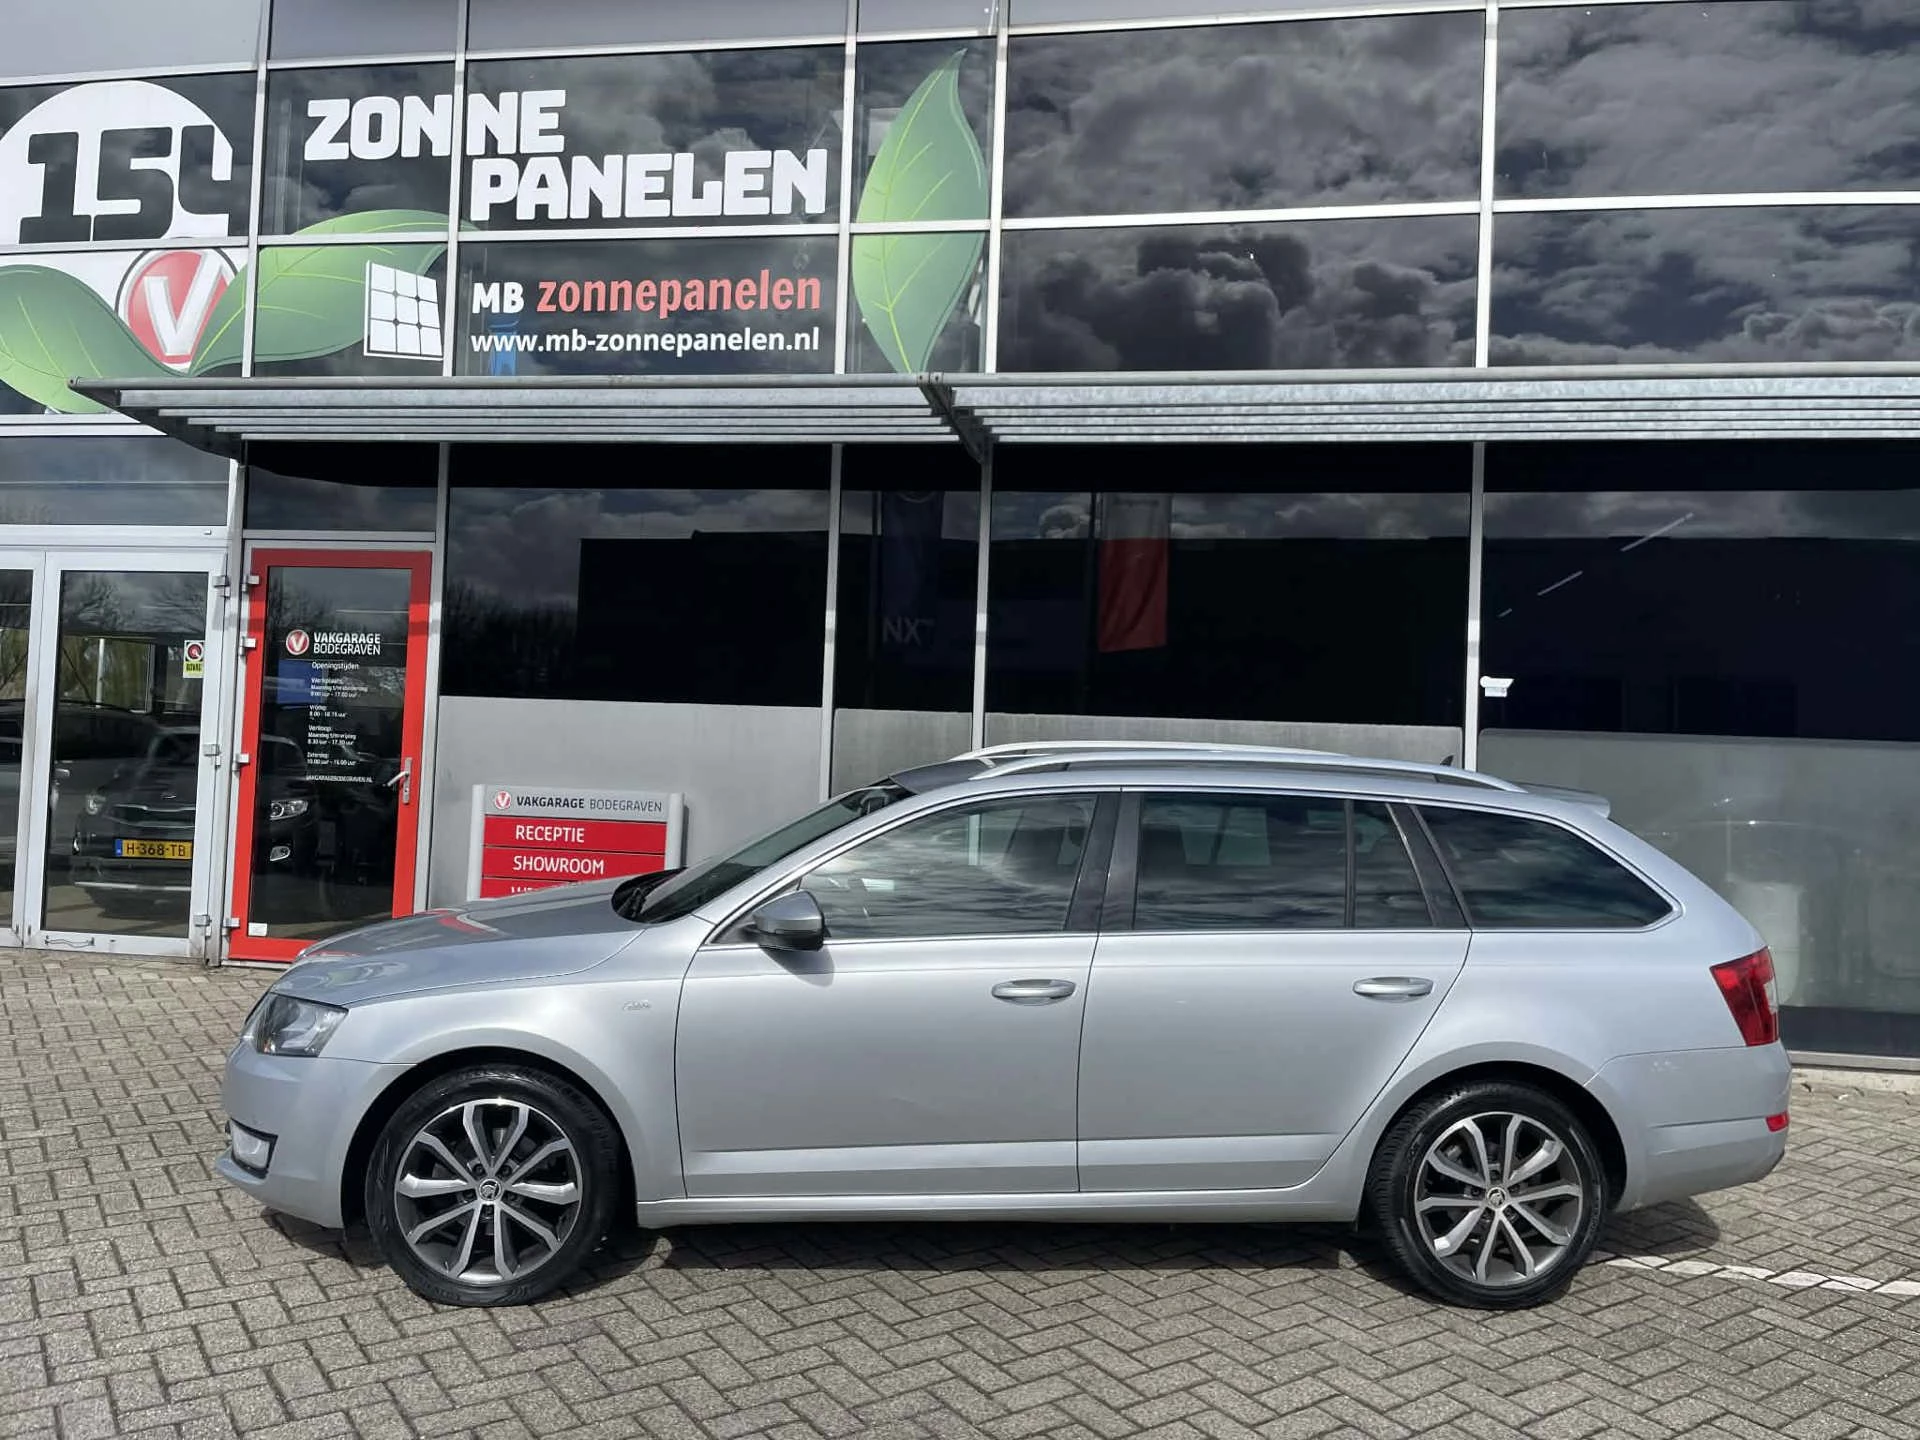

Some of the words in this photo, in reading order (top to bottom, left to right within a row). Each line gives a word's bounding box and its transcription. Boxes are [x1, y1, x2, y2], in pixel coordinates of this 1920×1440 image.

[304, 89, 566, 161] ZONNE
[19, 124, 233, 244] 154
[470, 148, 828, 221] PANELEN
[472, 281, 524, 314] MB
[536, 269, 822, 319] zonnepanelen
[470, 326, 820, 358] www.mb-zonnepanelen.nl
[313, 632, 381, 644] VAKGARAGE
[313, 643, 381, 655] BODEGRAVEN
[311, 661, 360, 671] Openingstijden
[516, 796, 585, 809] VAKGARAGE
[590, 798, 662, 812] BODEGRAVEN
[515, 825, 585, 843] RECEPTIE
[513, 856, 605, 875] SHOWROOM
